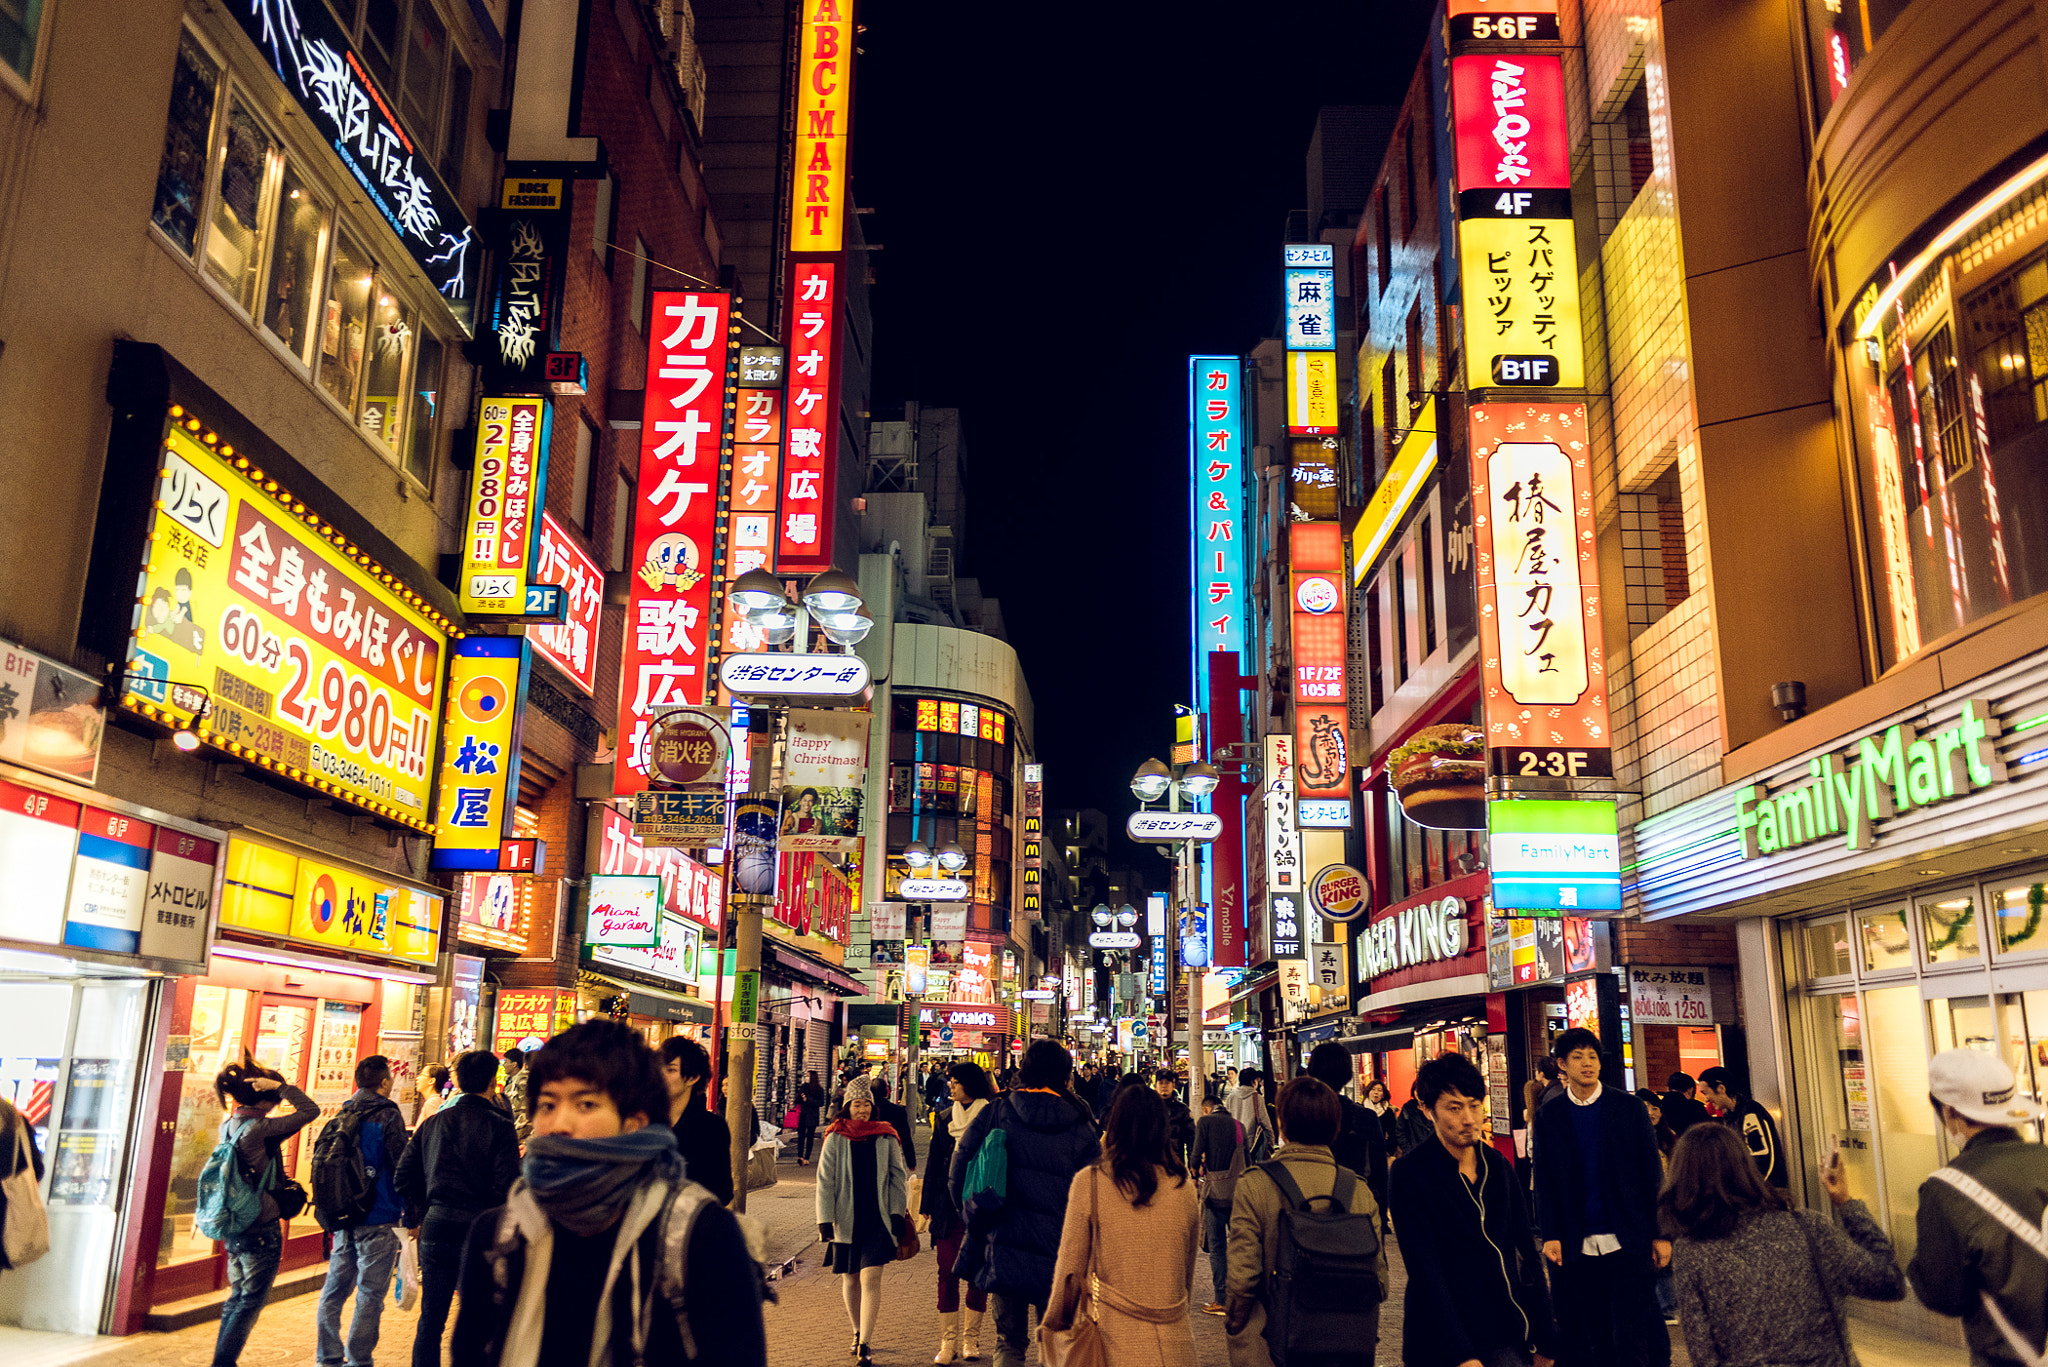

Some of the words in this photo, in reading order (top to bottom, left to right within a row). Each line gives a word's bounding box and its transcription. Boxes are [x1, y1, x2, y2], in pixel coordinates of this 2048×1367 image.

[806, 0, 841, 235] ABC-MART
[518, 183, 549, 194] ROCK
[508, 195, 556, 207] FASHION
[1494, 193, 1533, 215] 4F
[1287, 250, 1331, 261] センタービル
[1488, 251, 1514, 337] ピッツァ
[1528, 225, 1557, 350] スパゲッティ
[1298, 281, 1322, 335] 麻雀
[549, 357, 574, 376] 3F
[1501, 360, 1550, 380] B1F
[484, 406, 508, 421] 60分
[648, 295, 719, 527] カラオケ
[786, 275, 828, 544] カラオケ歌広場
[740, 391, 774, 506] カラオケ
[502, 410, 535, 563] 全身もみほぐし
[170, 468, 222, 538] りらく
[1502, 472, 1562, 674] 椿屋カフェ
[234, 521, 433, 696] 全身もみほぐし
[526, 590, 557, 612] 2F
[5, 651, 36, 678] B1F
[728, 665, 861, 684] 渋谷センター街
[1298, 666, 1342, 681] 1F/2F
[665, 728, 679, 737] FIRE
[680, 728, 707, 737] HYDRANT
[658, 739, 712, 765] 消火栓
[792, 736, 832, 752] Happy
[794, 753, 861, 767] Christmas!
[448, 735, 499, 828] 松屋
[1735, 699, 1992, 859] FamilyMart
[24, 795, 49, 816] 4F
[1300, 806, 1349, 820] センタービル
[107, 817, 129, 838] 5F
[651, 814, 716, 824] 03-3464-2061
[1134, 820, 1217, 832] 渋谷センター街
[177, 836, 197, 855] 6F
[507, 844, 531, 869] 1F
[1521, 844, 1610, 861] FamilyMart
[150, 880, 208, 913] メトロビル
[1320, 877, 1359, 894] BURGER
[1321, 886, 1362, 908] KING
[591, 903, 641, 917] Miami
[1221, 882, 1236, 947] Y!mobile
[1399, 895, 1468, 966] KING
[1274, 943, 1299, 954] B1F
[1320, 949, 1337, 985] 寿司
[1521, 966, 1531, 980] 4F
[1632, 969, 1705, 985] 飲み放題
[1287, 966, 1301, 997] 寿司
[501, 994, 553, 1017] カラオケ
[739, 973, 753, 1022] 客引きは犯罪
[499, 1012, 551, 1040] 歌広場
[919, 1009, 996, 1027] Monald's
[729, 1027, 756, 1039] STOP
